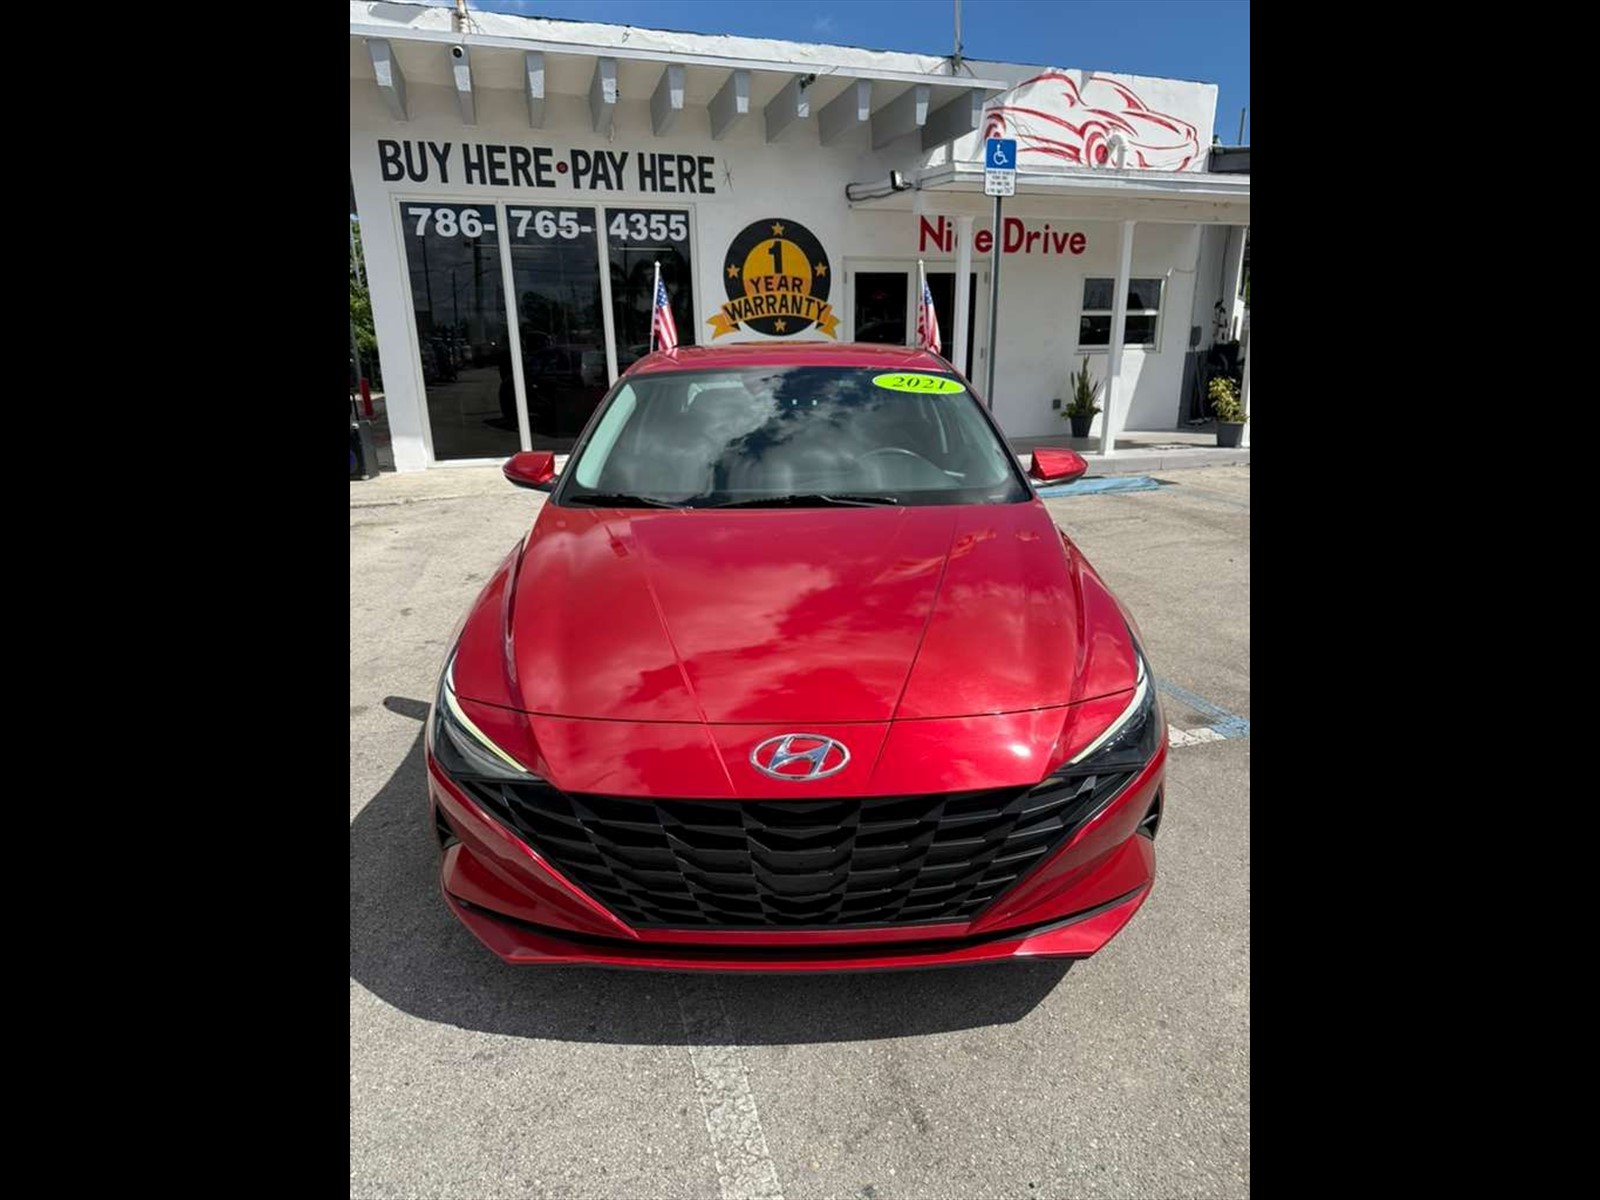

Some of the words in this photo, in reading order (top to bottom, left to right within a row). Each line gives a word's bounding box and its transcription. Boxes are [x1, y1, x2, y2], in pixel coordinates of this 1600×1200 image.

[378, 139, 451, 184] BUY
[462, 143, 556, 188] HERE
[570, 149, 629, 190] PAY
[638, 153, 716, 194] HERE
[408, 207, 496, 238] 786-
[510, 209, 592, 240] 765-
[609, 213, 688, 242] 4355
[919, 215, 993, 253] Nie
[1003, 217, 1087, 254] Drive
[768, 241, 783, 274] 1
[750, 275, 803, 294] YEAR
[722, 294, 828, 322] WARRANTY
[892, 376, 946, 390] 2021
